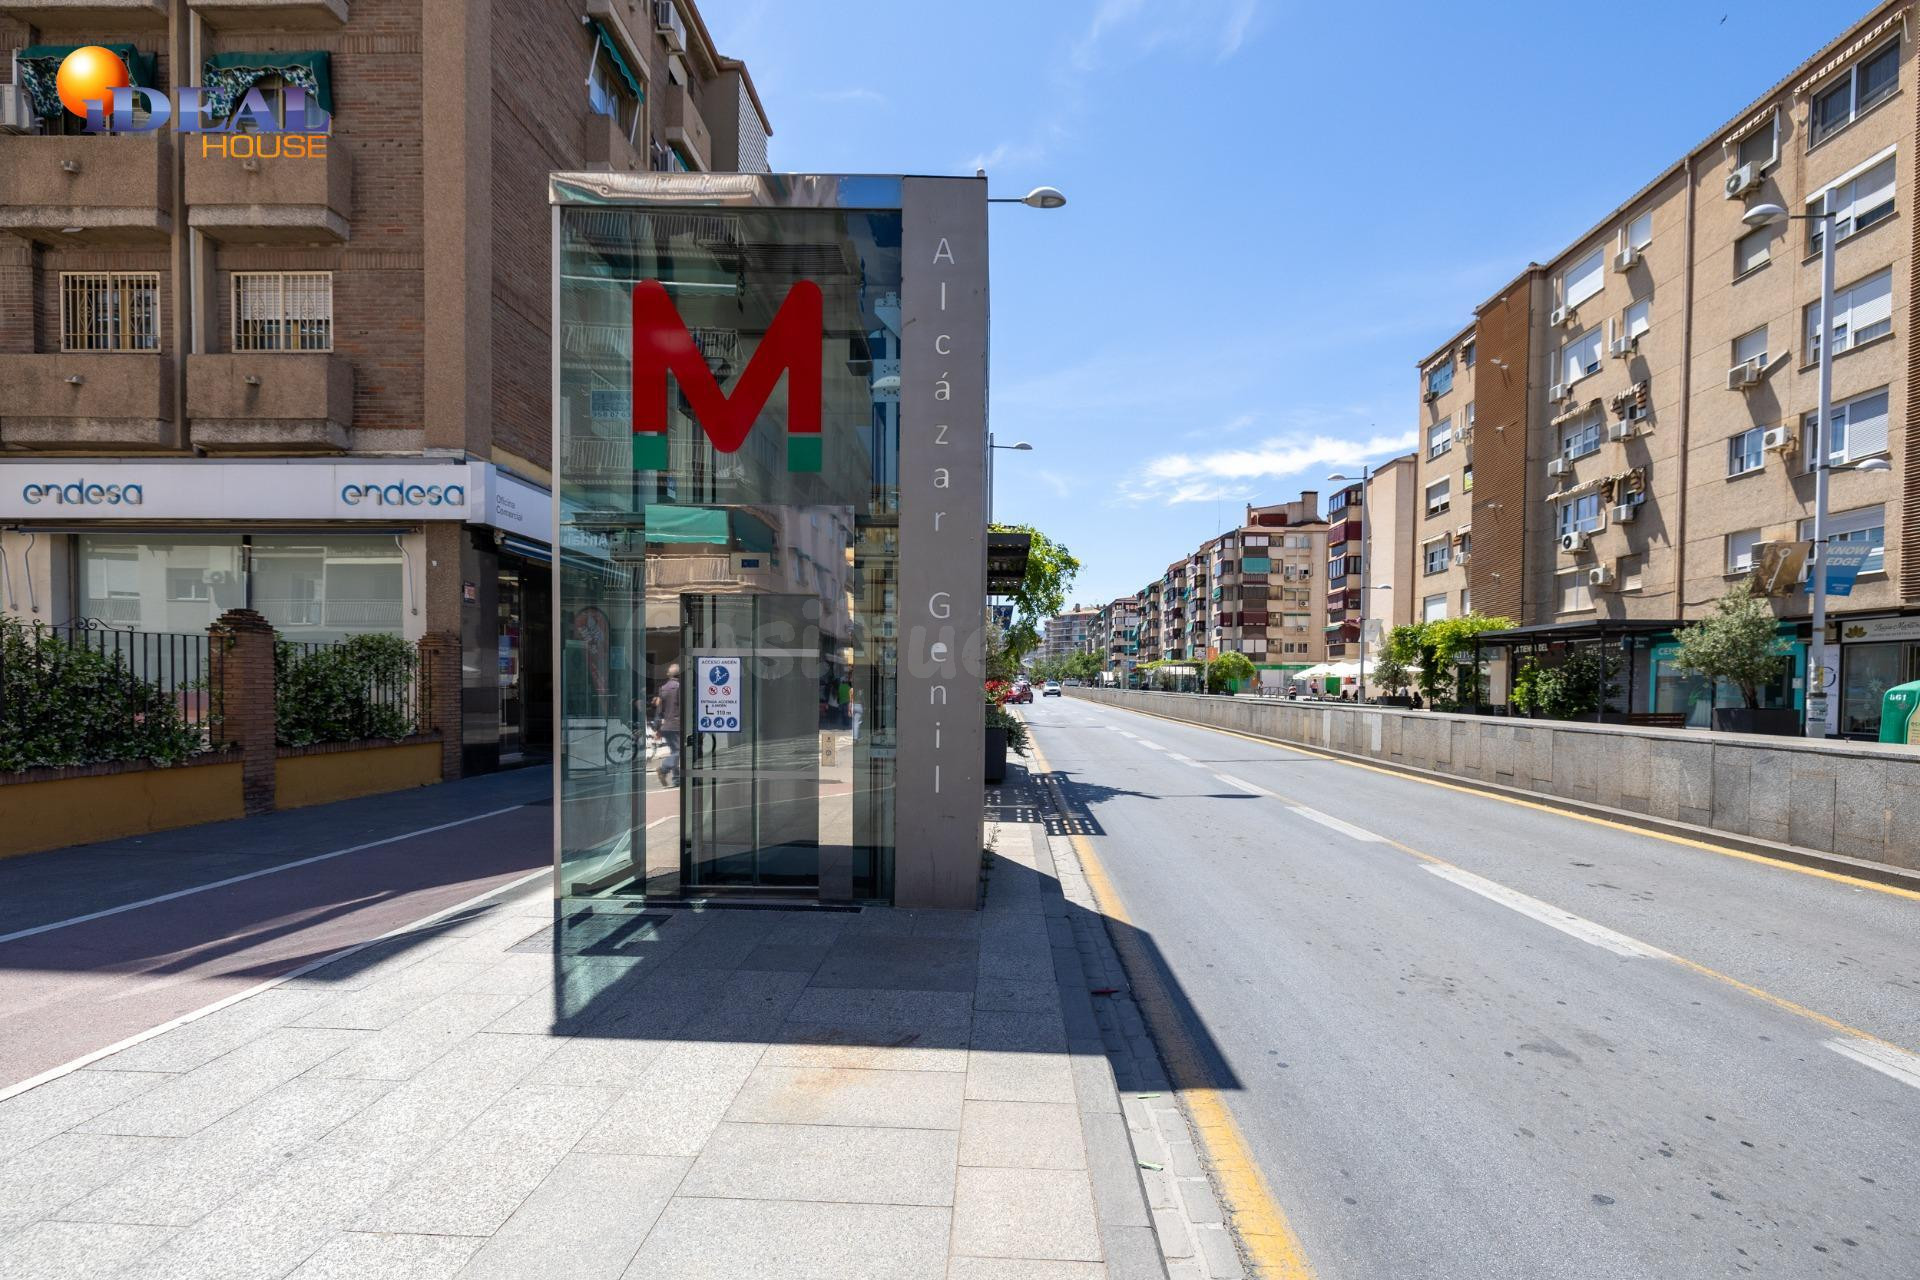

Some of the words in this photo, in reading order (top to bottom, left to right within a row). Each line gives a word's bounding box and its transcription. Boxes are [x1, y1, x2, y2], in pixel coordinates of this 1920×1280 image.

[632, 279, 823, 472] M
[932, 236, 955, 531] Alcázar
[22, 477, 143, 505] endesa
[341, 478, 465, 506] endesa
[496, 494, 516, 509] Oficina
[1826, 557, 1862, 566] EDGE
[928, 591, 953, 793] Genil
